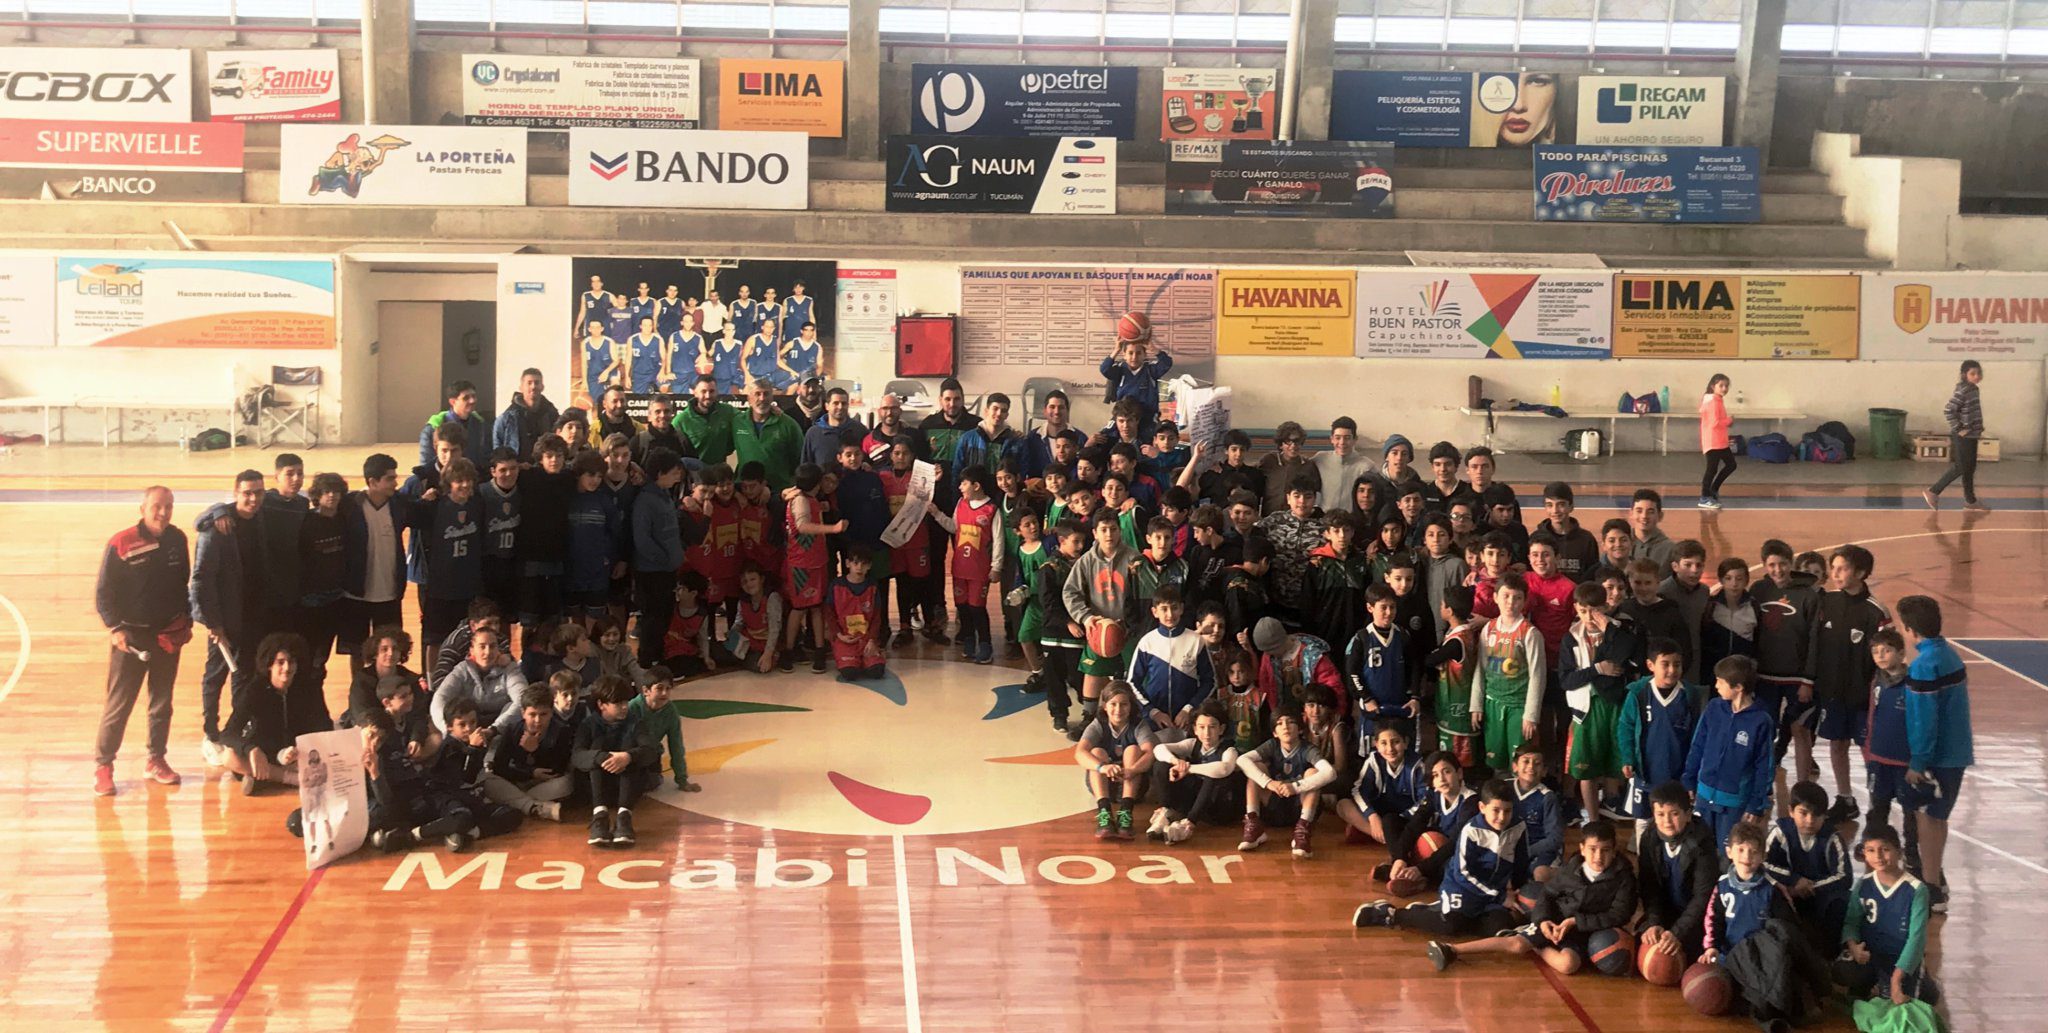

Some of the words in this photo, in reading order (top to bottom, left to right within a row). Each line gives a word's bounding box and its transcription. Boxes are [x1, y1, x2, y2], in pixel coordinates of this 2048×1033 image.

[476, 64, 496, 80] VC
[262, 66, 334, 94] Family
[739, 72, 823, 97] LIMA
[1042, 67, 1108, 94] petrel
[1426, 96, 1461, 105] ESTÉTICA
[1640, 87, 1706, 102] REGAM
[1402, 105, 1461, 114] COSMETOLOGÍA
[1639, 105, 1692, 119] PILAY
[37, 130, 203, 155] SUPERVIELLE
[1595, 136, 1610, 144] UN
[1613, 136, 1657, 144] AHORRO
[1660, 136, 1704, 144] SEGURO
[1175, 144, 1218, 154] RE/MAX
[416, 151, 436, 163] LA
[440, 149, 516, 164] PORTEÑA
[1539, 152, 1573, 161] TODO
[1576, 152, 1608, 161] PARA
[1610, 153, 1668, 162] PISCINAS
[429, 166, 462, 174] Pastas
[635, 150, 790, 185] BANDO
[972, 158, 1035, 175] NAUM
[1241, 169, 1280, 179] CUÁNTO
[1281, 171, 1317, 180] QUERÉS
[82, 176, 157, 195] BANCO
[1360, 177, 1388, 186] RE/MAX
[1541, 169, 1676, 203] Pireluxs
[892, 191, 978, 200] www.agnaum.com.ar
[963, 270, 1007, 279] FAMILIAS
[1010, 271, 1029, 279] QUE
[1031, 271, 1071, 280] APOYAN
[1146, 273, 1184, 281] MACABI
[1186, 273, 1213, 281] NOAR
[76, 278, 143, 296] Leiland
[177, 290, 213, 298] Hacemos
[214, 290, 246, 298] realidad
[1231, 287, 1343, 308] HAVANNA
[1621, 280, 1735, 311] LIMA
[1369, 306, 1425, 316] HOTEL
[1623, 310, 1666, 320] Servicios
[1669, 311, 1732, 320] Inmobiliarios
[1902, 297, 1922, 324] H
[1369, 317, 1405, 328] BUEN
[1412, 318, 1462, 329] PASTOR
[1368, 331, 1462, 341] Capuchinos
[673, 343, 679, 352] 5
[756, 347, 762, 356] 9
[715, 353, 721, 361] 6
[499, 532, 514, 549] 10
[453, 539, 468, 557] 15
[963, 545, 971, 557] 3
[919, 555, 927, 566] 5
[381, 847, 870, 892] Macabi
[935, 846, 1245, 886] Noar
